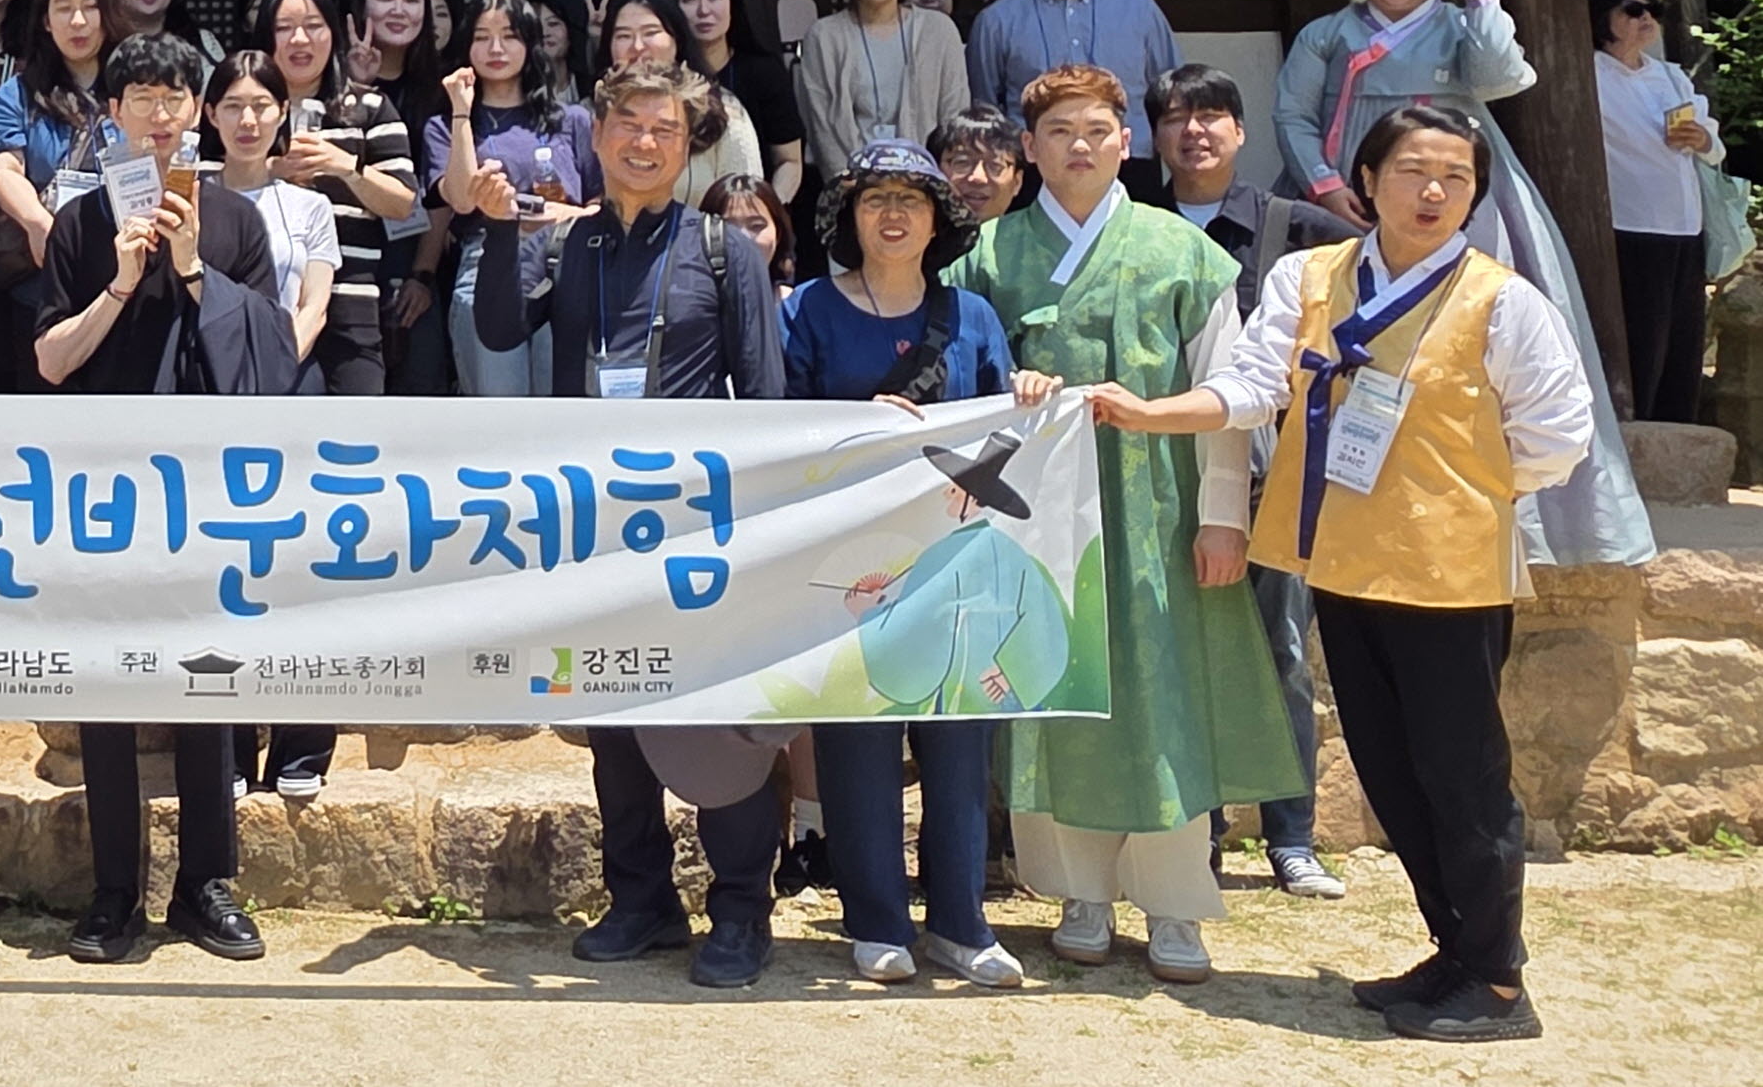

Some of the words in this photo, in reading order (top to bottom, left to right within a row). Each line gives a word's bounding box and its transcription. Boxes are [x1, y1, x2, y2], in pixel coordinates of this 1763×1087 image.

[120, 652, 158, 673] 주관
[253, 655, 425, 679] 전라남도종가회
[473, 653, 511, 674] 후원
[582, 647, 673, 675] 강진군
[255, 681, 358, 696] Jeollanamdo
[364, 682, 422, 698] Jongga
[582, 681, 640, 693] GANGJIN
[644, 681, 674, 693] CITY
